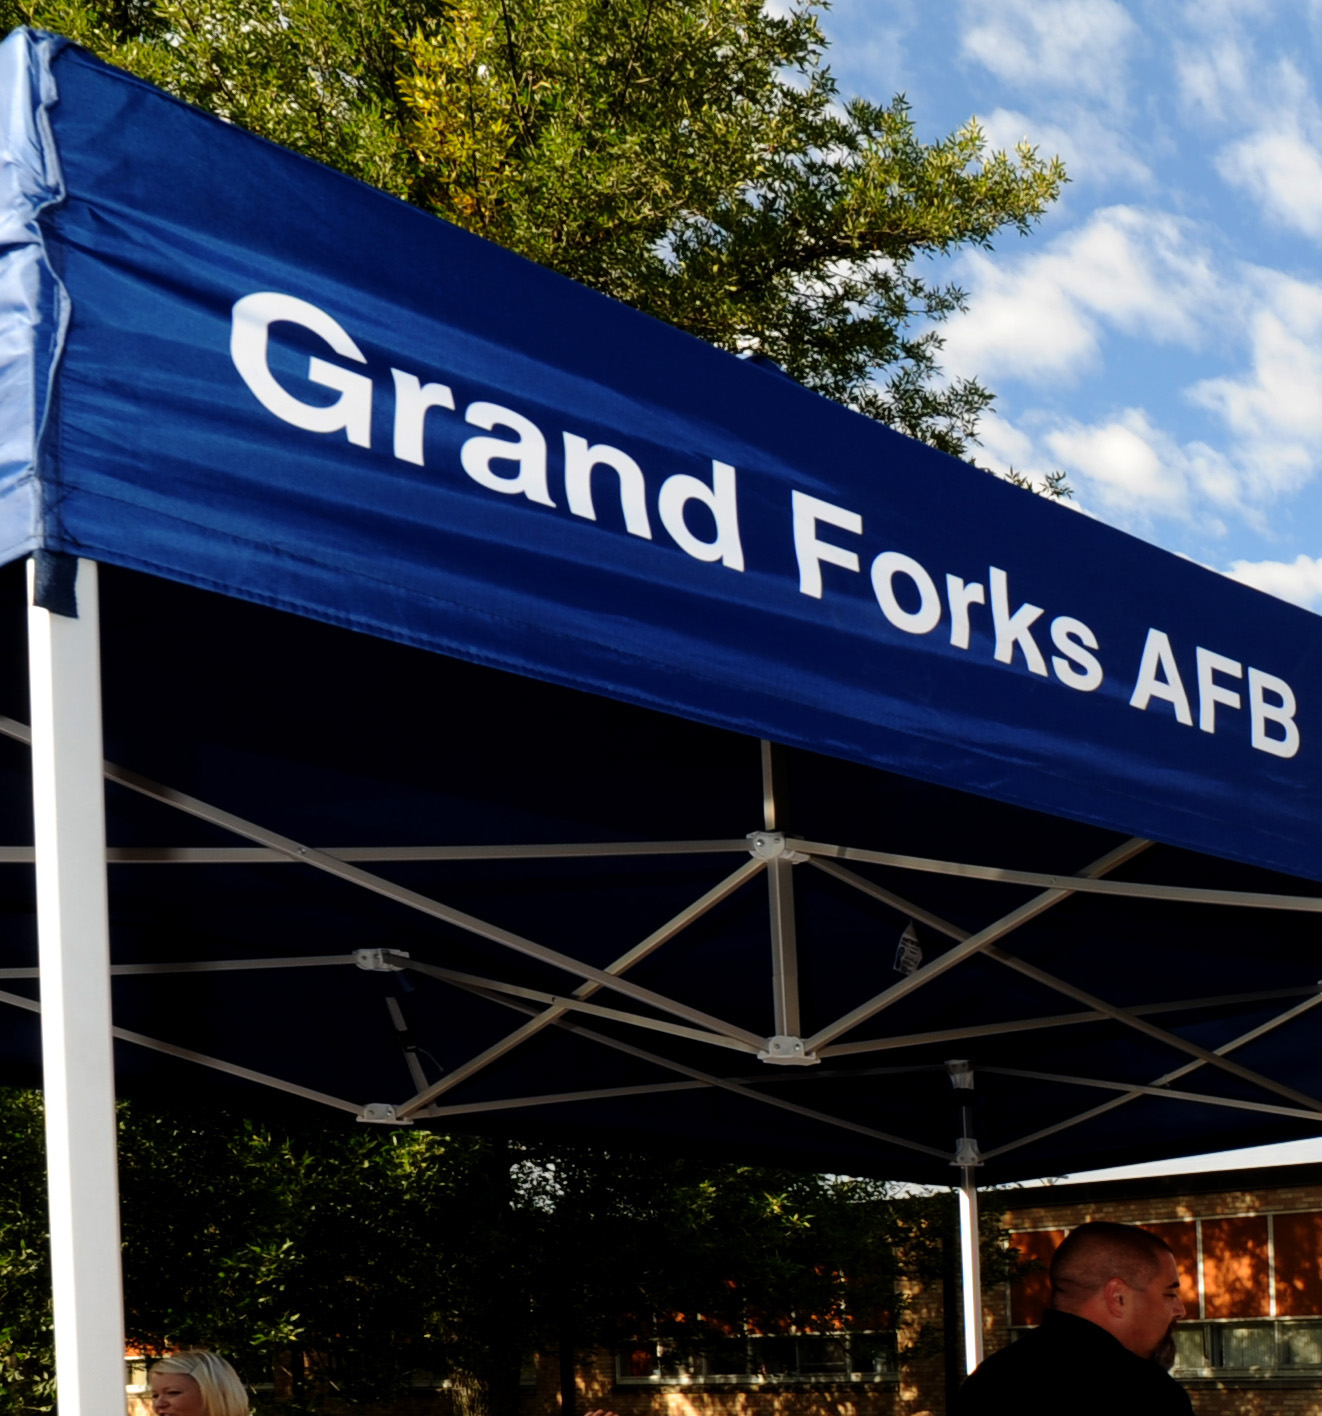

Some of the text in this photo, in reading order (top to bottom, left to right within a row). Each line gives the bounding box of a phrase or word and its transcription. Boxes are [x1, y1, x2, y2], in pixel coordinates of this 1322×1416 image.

[230, 290, 745, 573] Grand
[791, 489, 1104, 692] Forks
[1128, 627, 1300, 759] AFB
